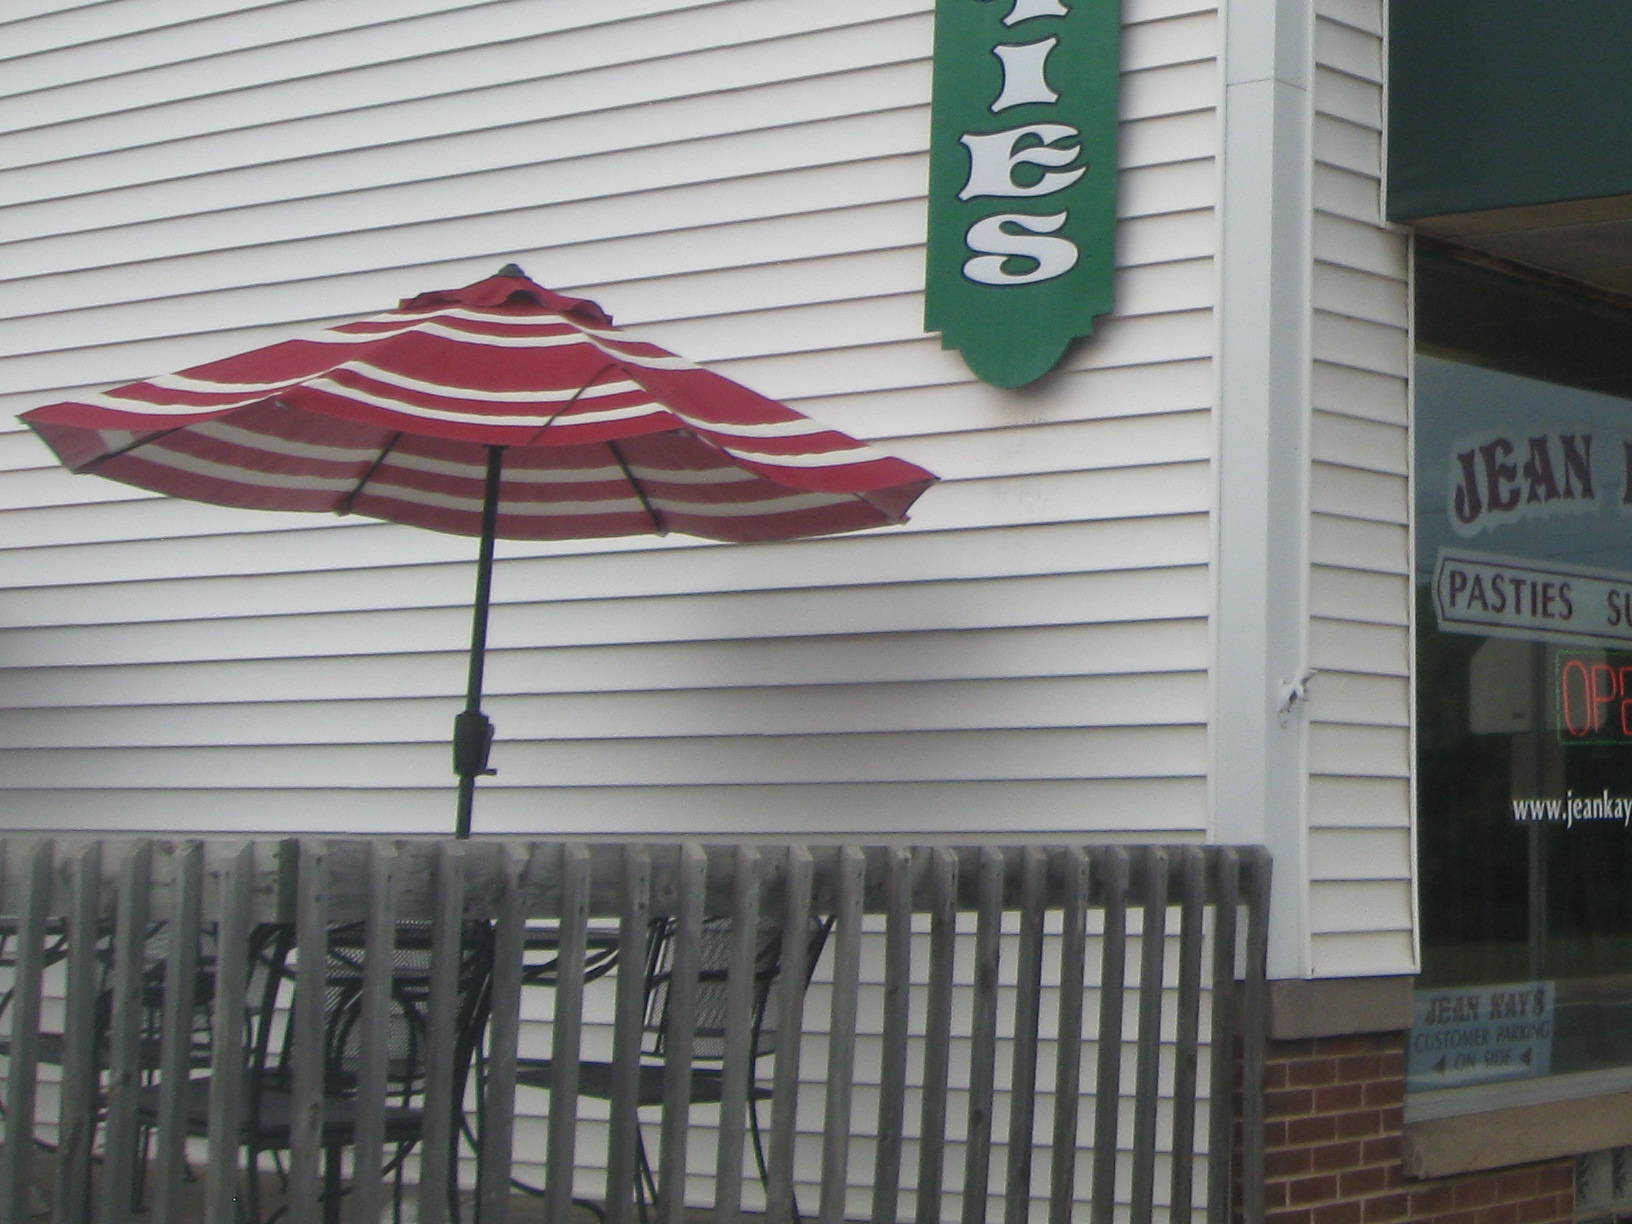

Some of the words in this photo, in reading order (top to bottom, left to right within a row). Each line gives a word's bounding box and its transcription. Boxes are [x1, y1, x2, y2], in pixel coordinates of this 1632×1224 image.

[1454, 433, 1595, 524] JEAN
[1448, 570, 1574, 620] PASTIES
[1424, 995, 1480, 1025] JEAN
[1414, 1028, 1489, 1053] CUSTOMER
[1495, 1020, 1551, 1044] PARKING
[1453, 1053, 1476, 1072] ON
